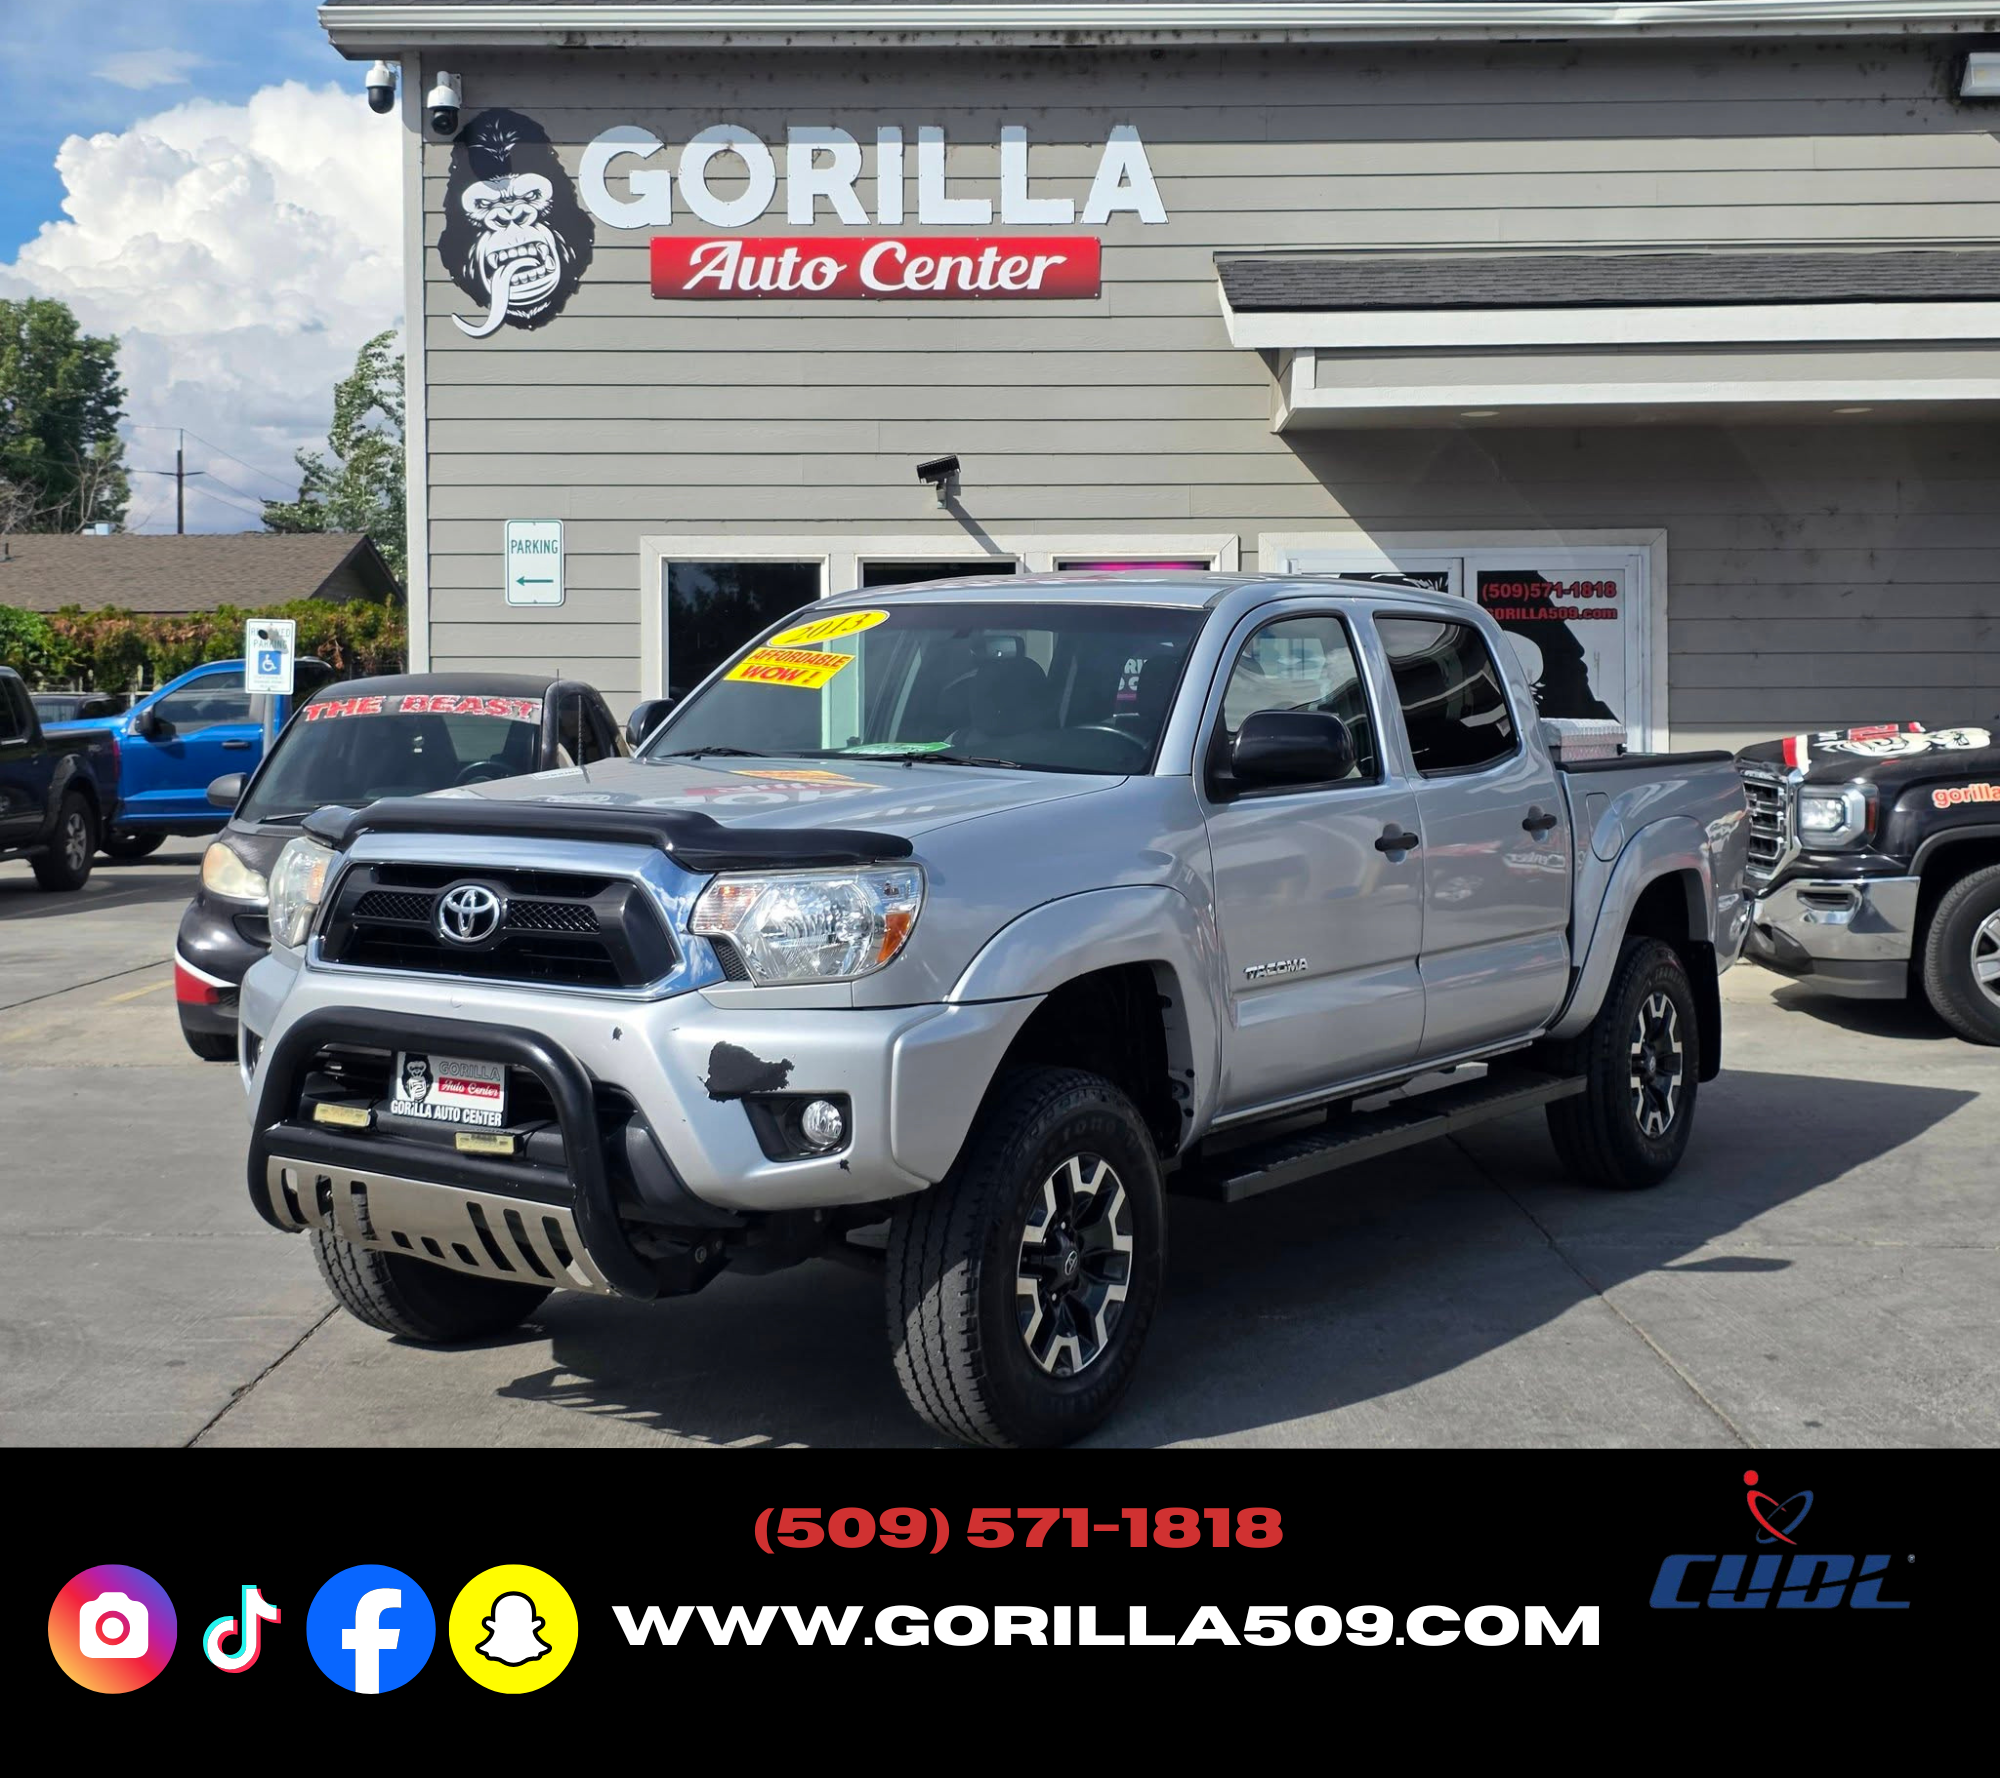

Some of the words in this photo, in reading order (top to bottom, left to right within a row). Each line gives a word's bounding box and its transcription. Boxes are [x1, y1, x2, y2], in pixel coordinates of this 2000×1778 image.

[579, 124, 1169, 229] GORILLA
[682, 241, 847, 292] Auto
[859, 241, 1067, 292] Center
[510, 539, 558, 554] PARKING
[1482, 581, 1617, 601] (509)571-1818
[785, 612, 871, 643] 2013
[253, 639, 288, 649] PARKING
[750, 649, 851, 668] AFFORDABLE
[740, 665, 808, 681] WOW
[303, 696, 386, 722] THE
[399, 695, 540, 719] BEAST
[1244, 958, 1308, 979] TACOMA
[439, 1060, 501, 1081] GORILLA
[442, 1079, 466, 1093] Auto
[468, 1082, 499, 1097] Center
[390, 1100, 432, 1118] GORILLA
[433, 1104, 460, 1122] AUTO
[462, 1109, 502, 1127] CENTER
